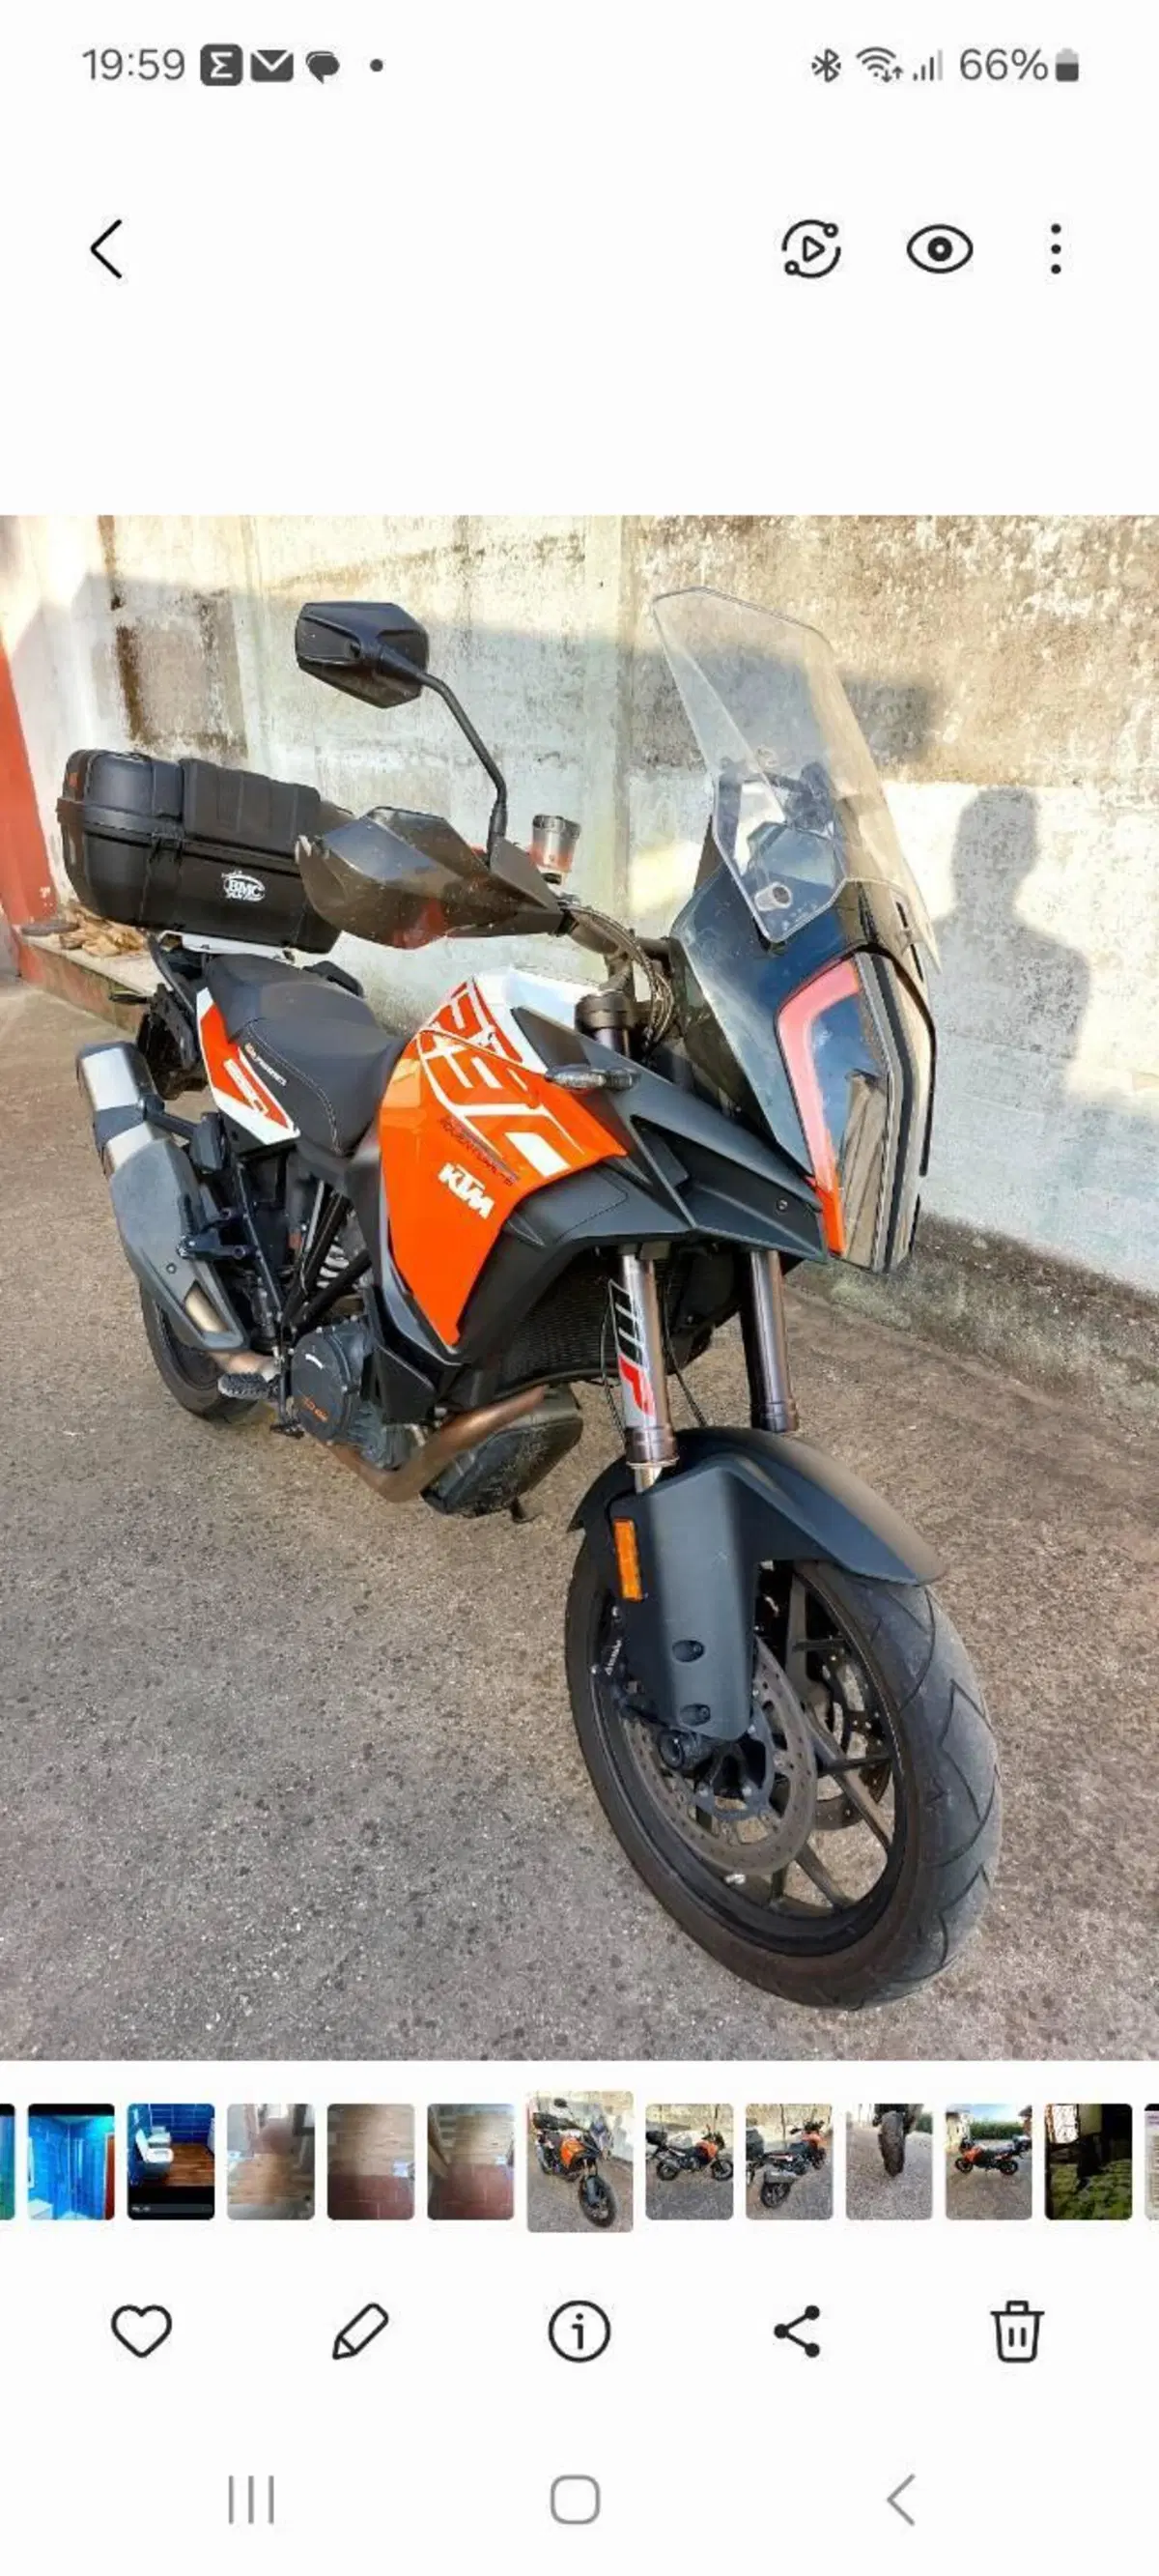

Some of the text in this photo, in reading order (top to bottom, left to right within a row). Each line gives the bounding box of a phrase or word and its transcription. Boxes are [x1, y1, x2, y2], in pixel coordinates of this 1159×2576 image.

[82, 48, 185, 80] 19:59
[960, 48, 1049, 80] 66%
[438, 1162, 495, 1219] KTM
